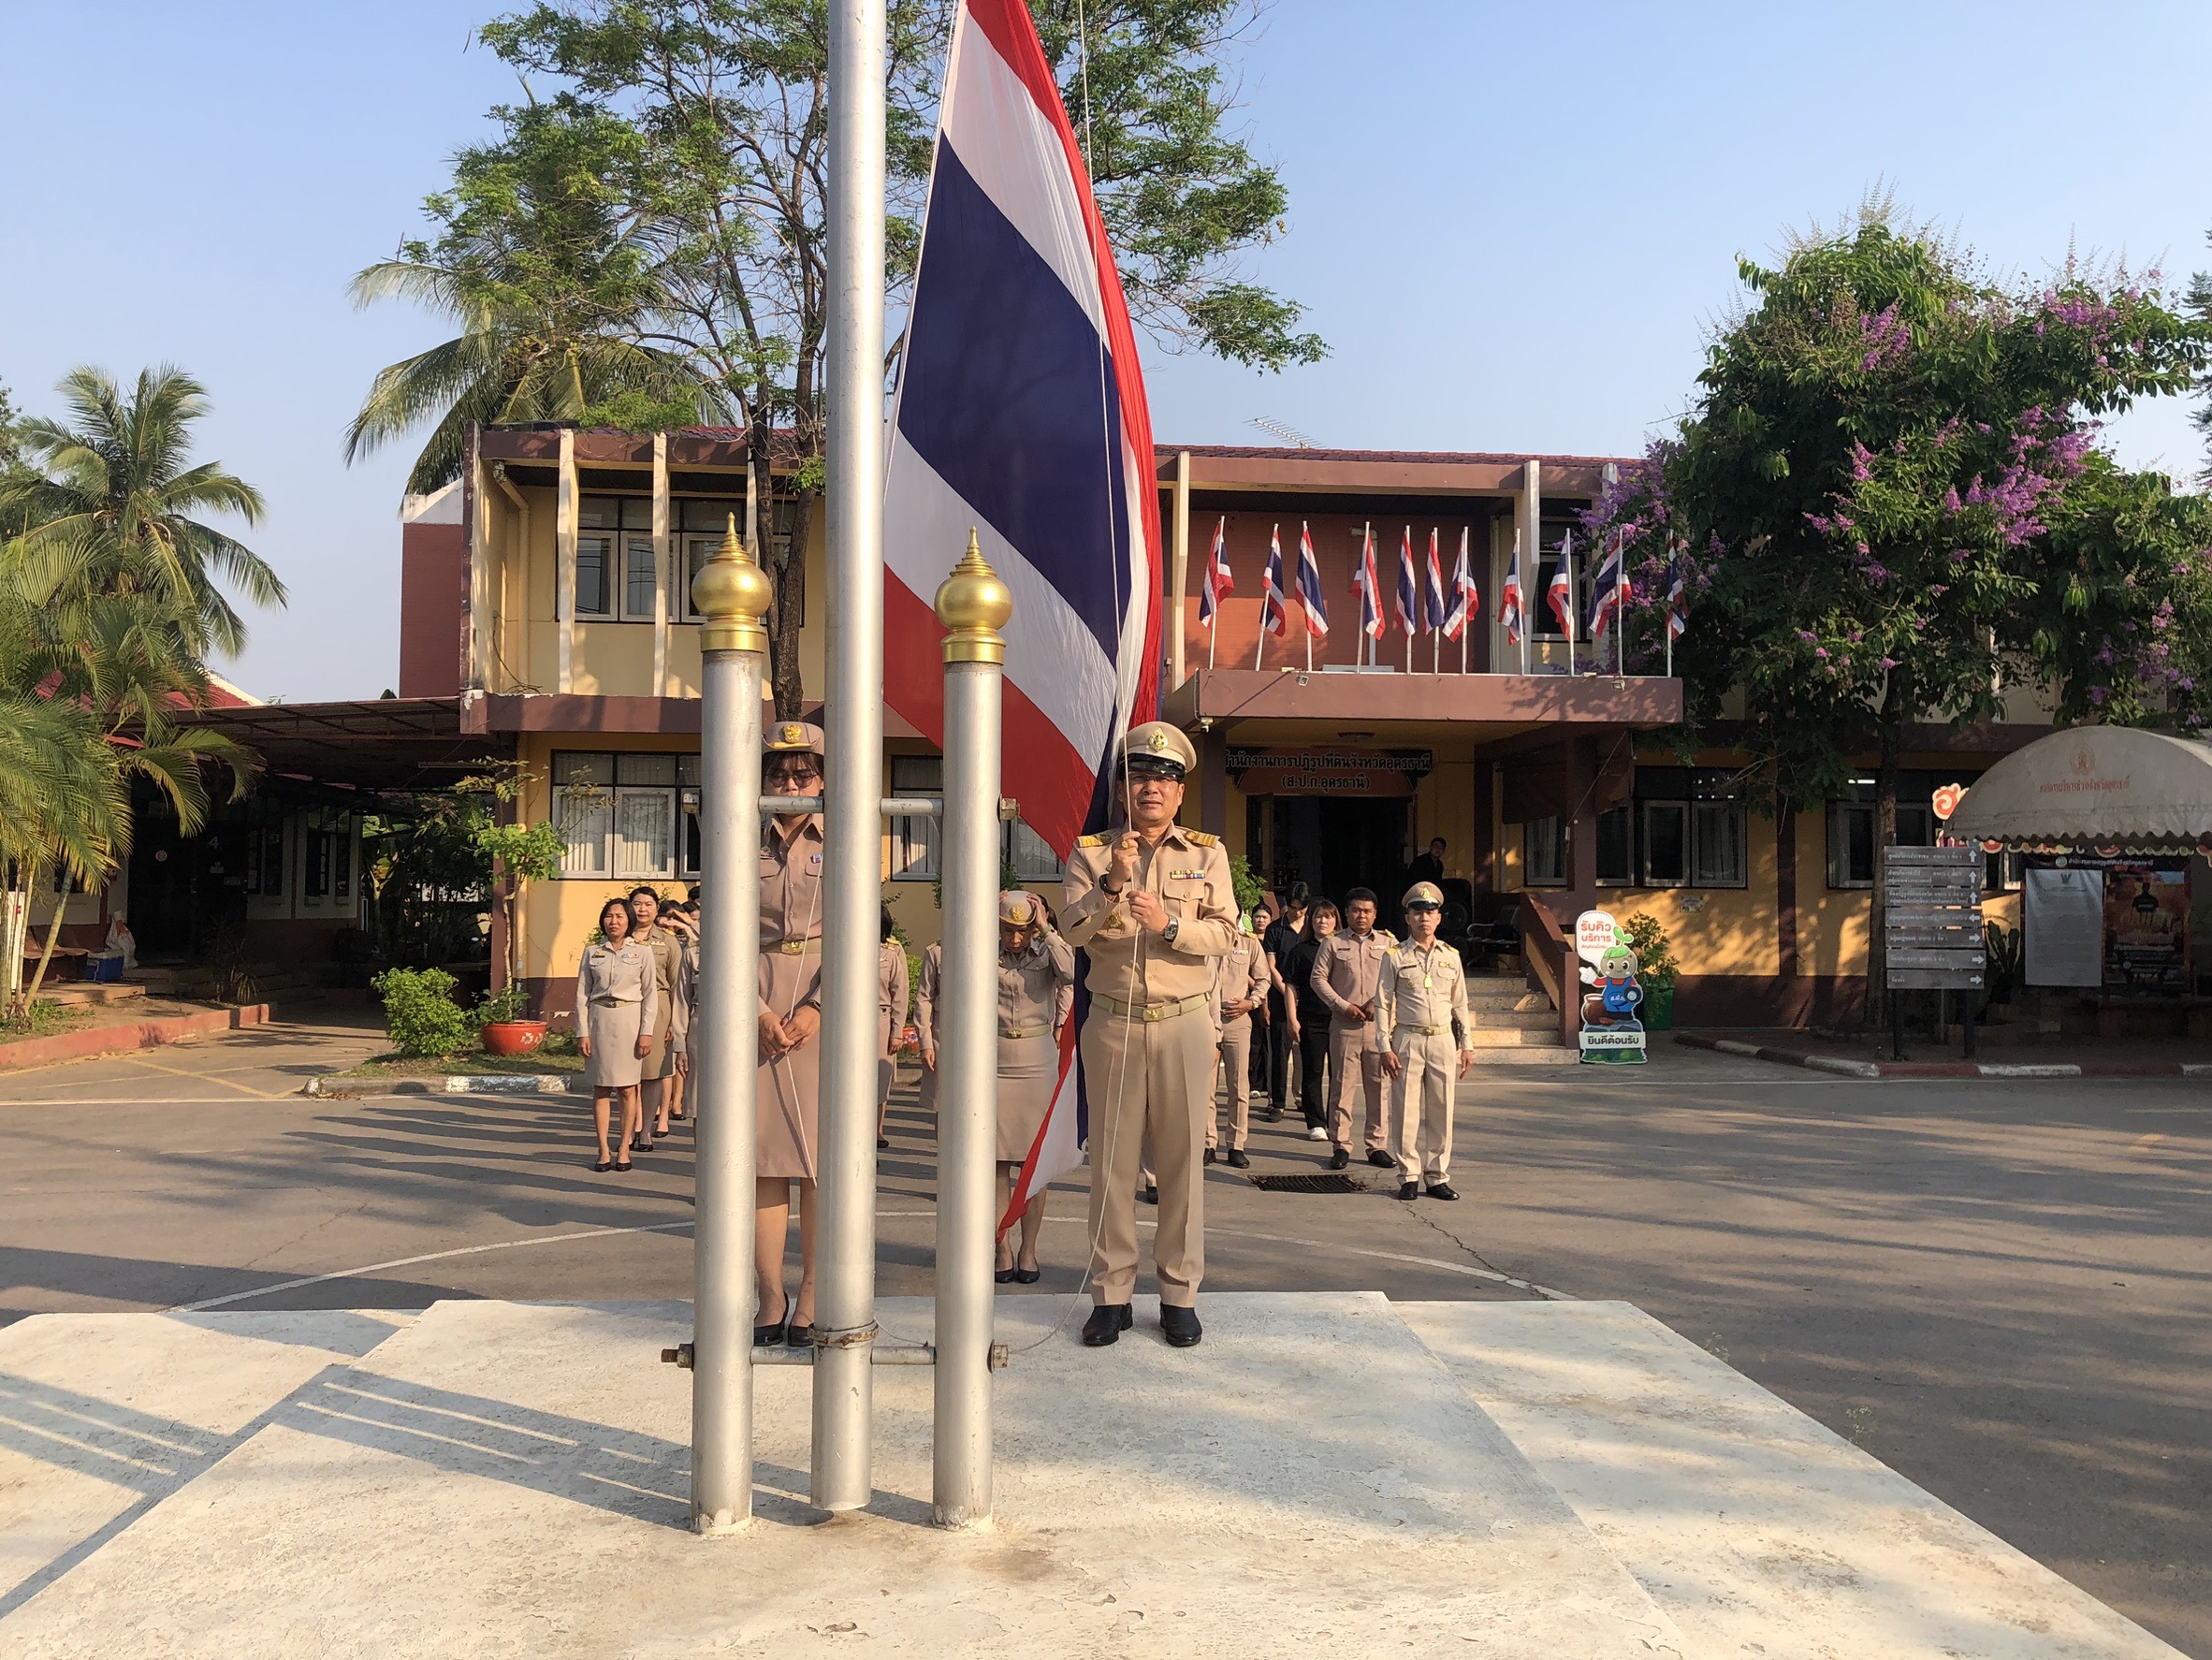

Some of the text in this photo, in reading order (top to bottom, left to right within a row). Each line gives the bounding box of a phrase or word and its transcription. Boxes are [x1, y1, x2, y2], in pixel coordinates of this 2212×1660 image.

[1281, 773, 1370, 793] (ส.ป.ก.อุดรธานี)
[1580, 920, 1611, 932] รับคิว
[1581, 933, 1611, 942] บริการ
[1587, 1034, 1639, 1045] ยินดีต้อนรับ
